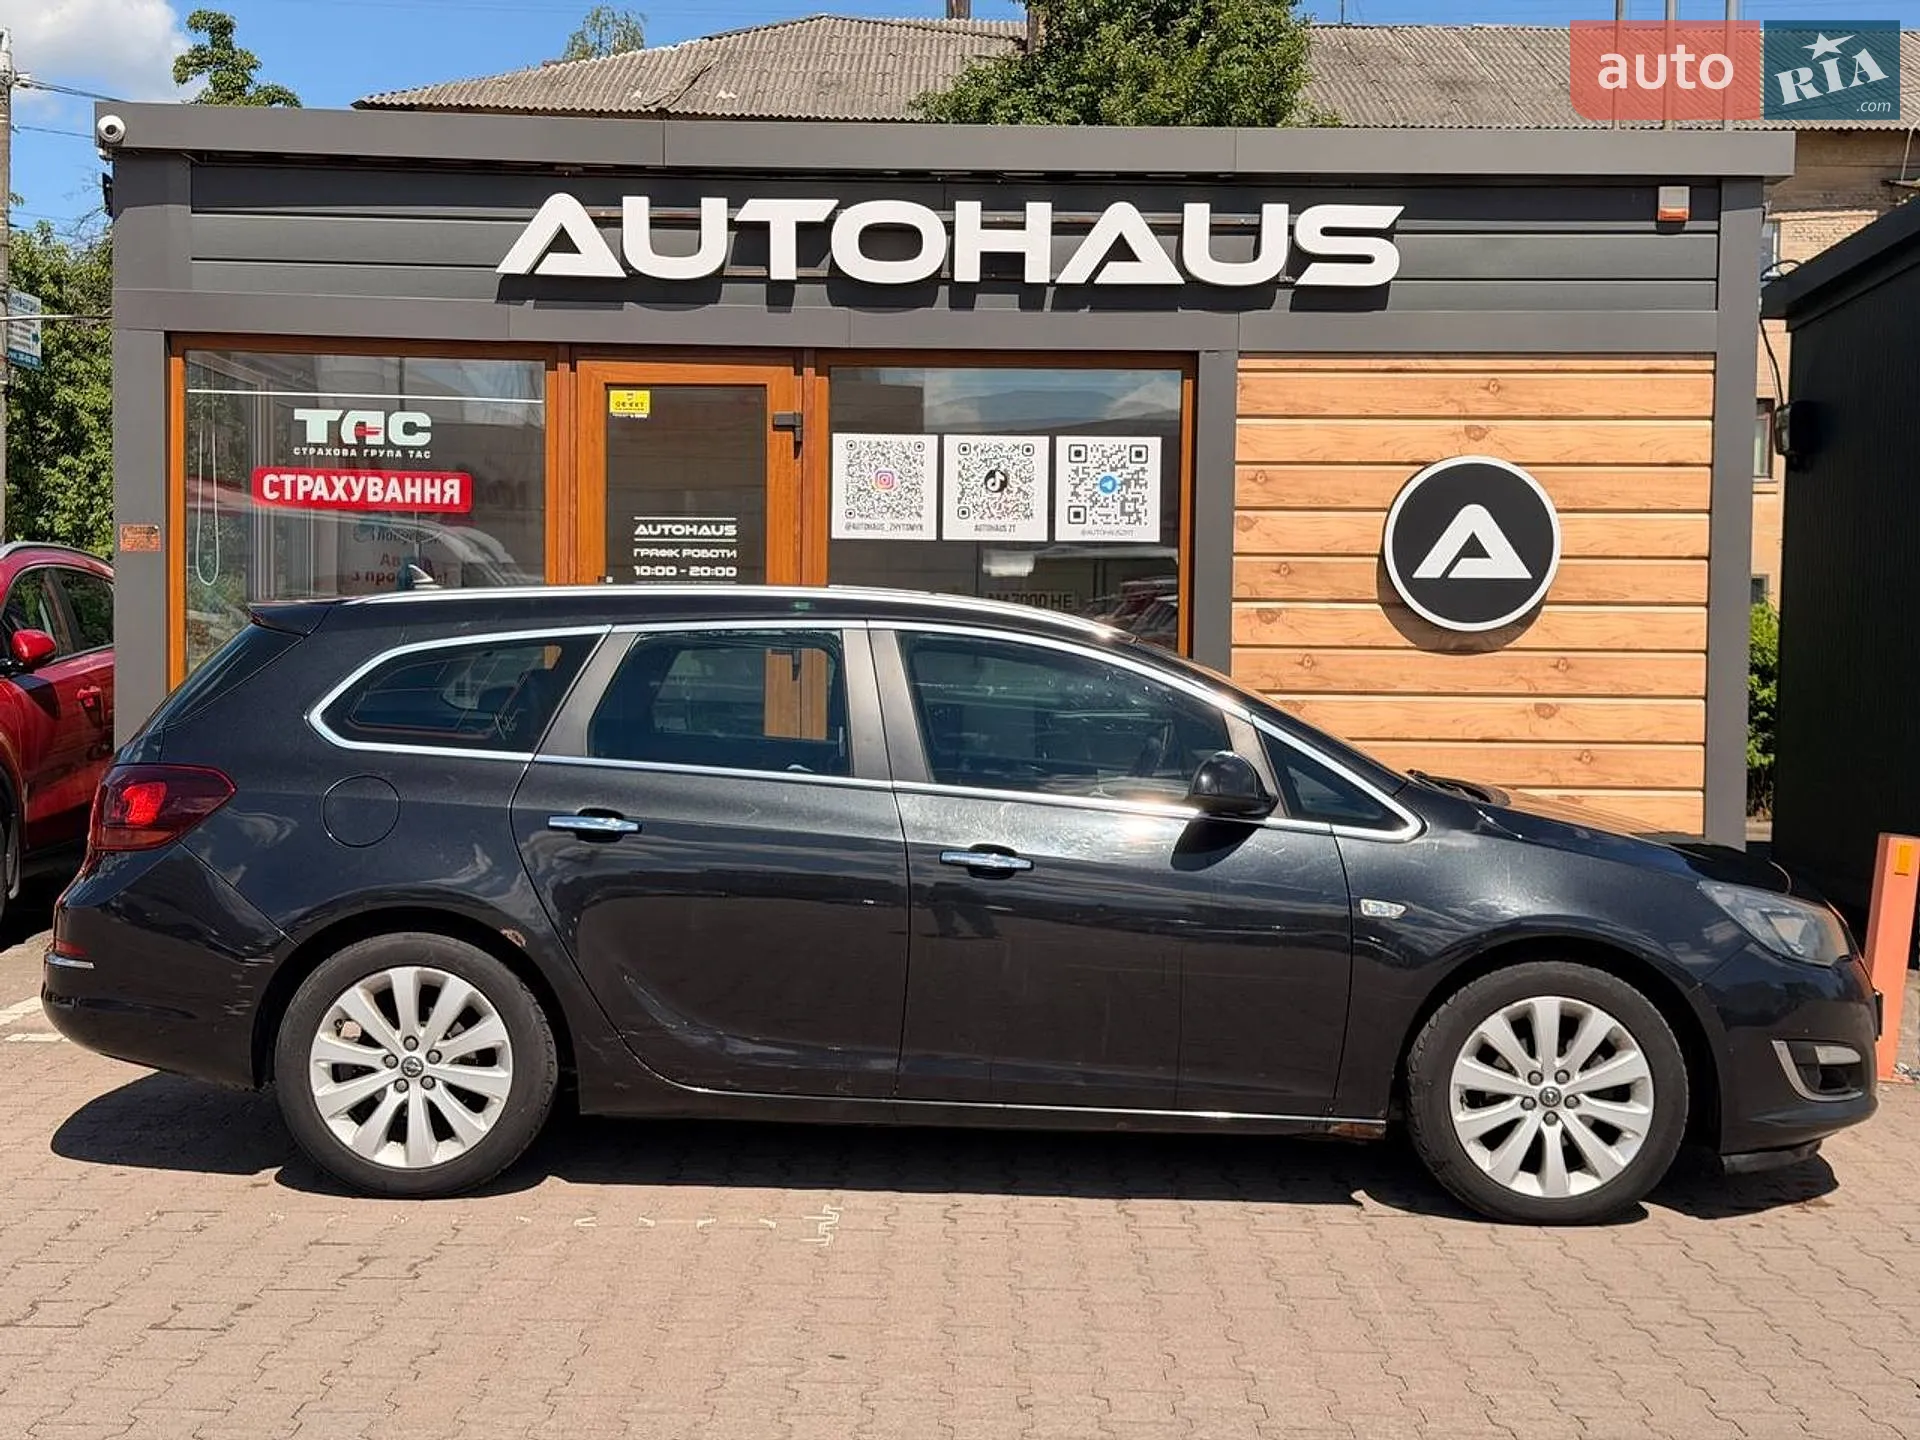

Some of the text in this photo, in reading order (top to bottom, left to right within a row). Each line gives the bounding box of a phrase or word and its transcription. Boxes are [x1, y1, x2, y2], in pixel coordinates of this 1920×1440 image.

[495, 191, 1405, 287] AUTOHAUS
[293, 446, 431, 459] СТРАХОВА ГРУПА ТАС
[262, 473, 461, 505] СТРАХУВАННЯ
[634, 524, 738, 536] AUTOHAUS
[633, 548, 738, 559] ГРАФІК РОБОТИ
[633, 565, 677, 577] 10:00
[689, 566, 738, 578] 20:00
